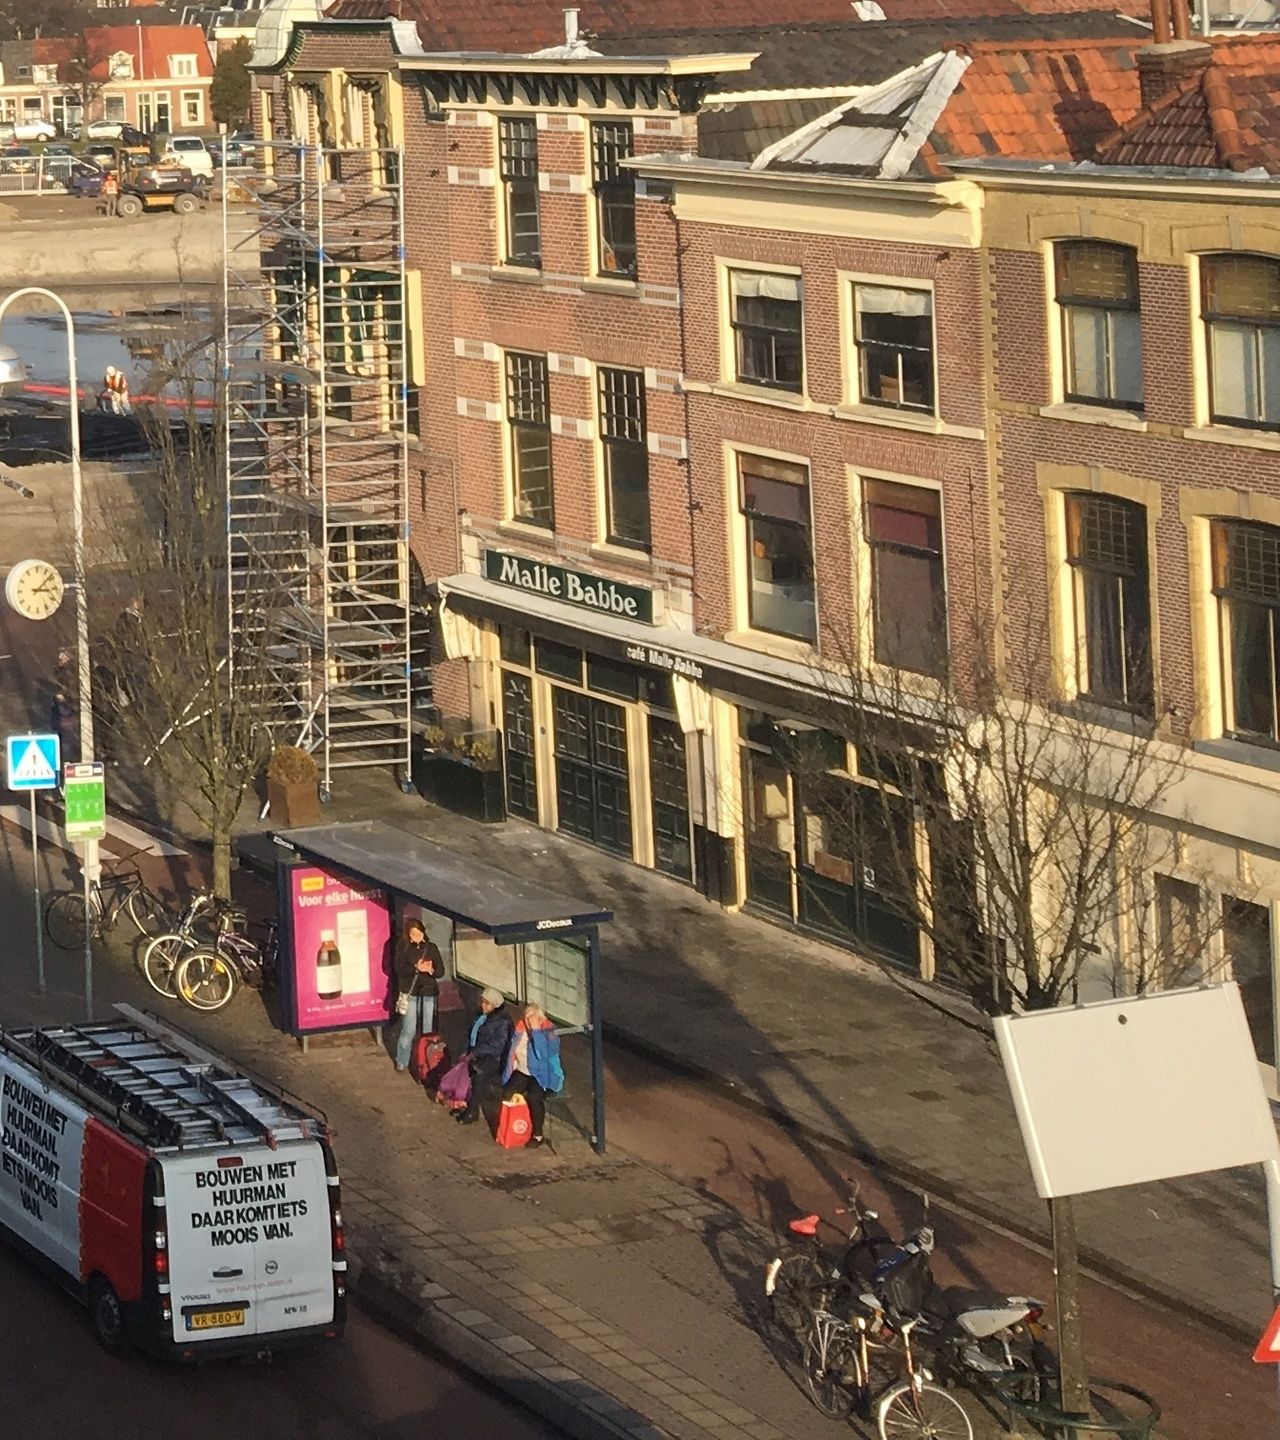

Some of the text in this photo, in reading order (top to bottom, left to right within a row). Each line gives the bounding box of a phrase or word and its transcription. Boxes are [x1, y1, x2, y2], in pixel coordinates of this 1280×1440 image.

[500, 556, 639, 617] Malle Babbe
[649, 649, 674, 669] Malle
[298, 895, 323, 907] Voor
[325, 891, 349, 905] elke
[536, 919, 573, 930] JCDecaux
[3, 1074, 68, 1136] BOUWEN MET
[2, 1126, 60, 1183] DAAR KOMT
[2, 1151, 58, 1209] IETS MOOIS
[196, 1161, 297, 1188] BOUWEN MET
[212, 1183, 286, 1207] HUURMAN
[191, 1199, 308, 1229] DAAR KOMT IETS
[211, 1222, 294, 1247] MOOIS VAN.
